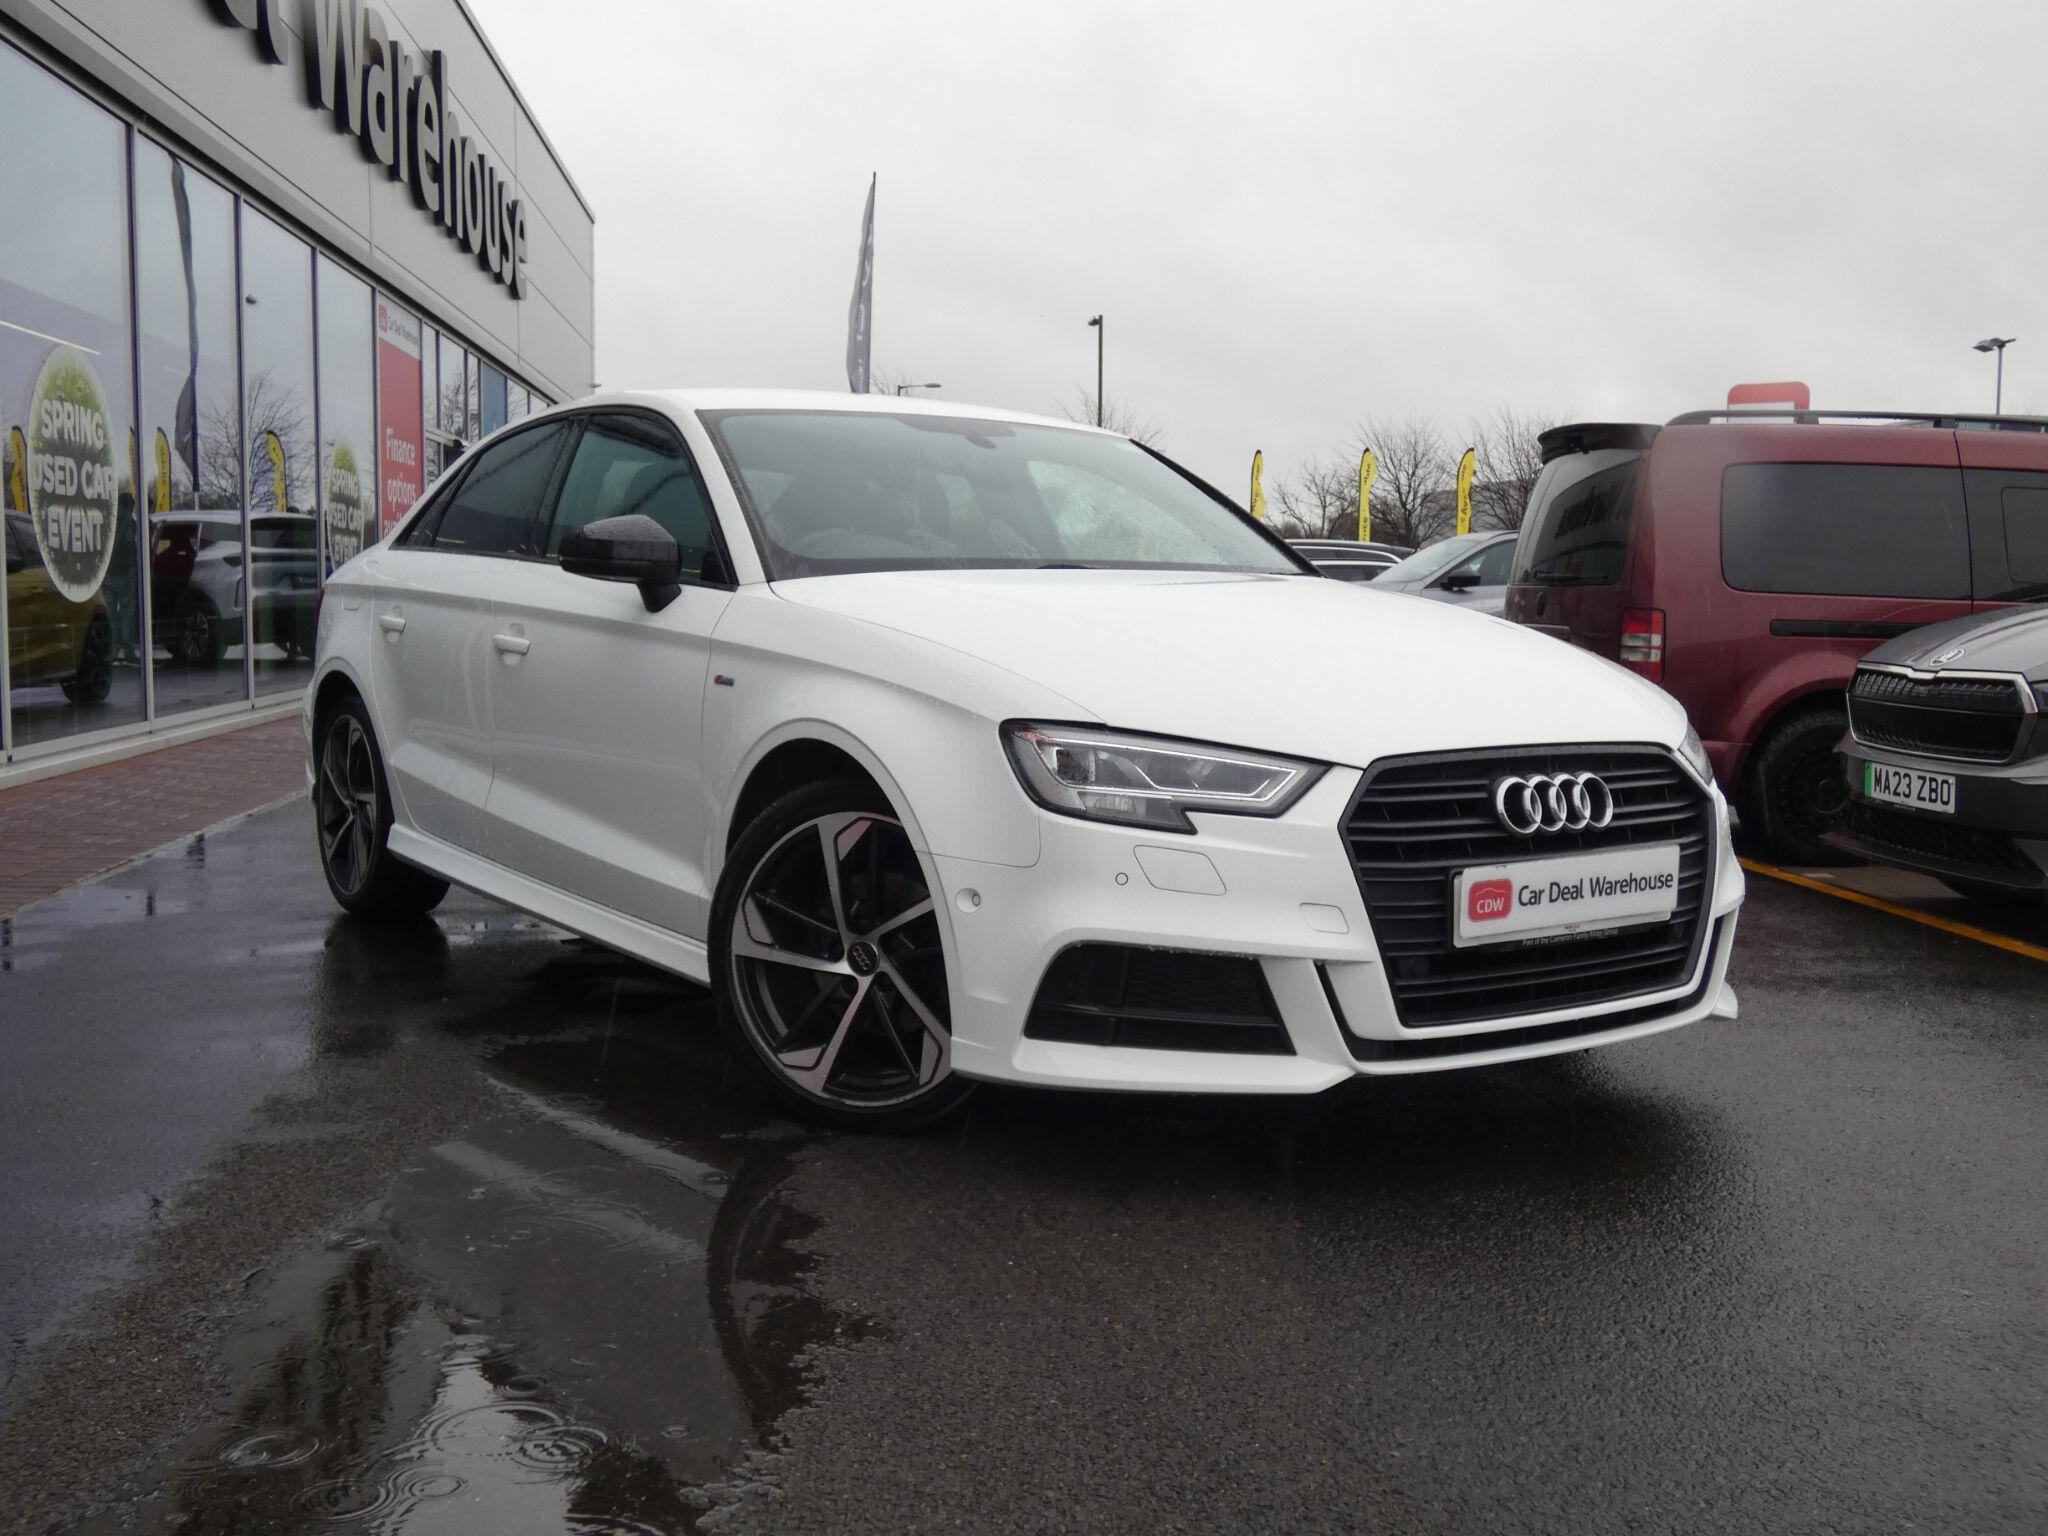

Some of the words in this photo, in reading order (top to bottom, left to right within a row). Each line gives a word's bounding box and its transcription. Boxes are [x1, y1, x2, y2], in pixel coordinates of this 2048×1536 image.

[41, 400, 104, 450] SPRING
[386, 427, 415, 467] Finance
[32, 453, 78, 497] USED
[81, 459, 115, 500] CAR
[332, 467, 359, 499] SPRING
[387, 473, 416, 512] options
[47, 505, 104, 553] EVENT
[327, 501, 347, 529] USED
[1874, 766, 1912, 799] MA23
[1917, 775, 1952, 806] ZBO
[1476, 897, 1505, 914] CDW
[1517, 884, 1545, 907] Car
[1549, 878, 1584, 904] Deal
[1589, 871, 1674, 898] Warehouse
